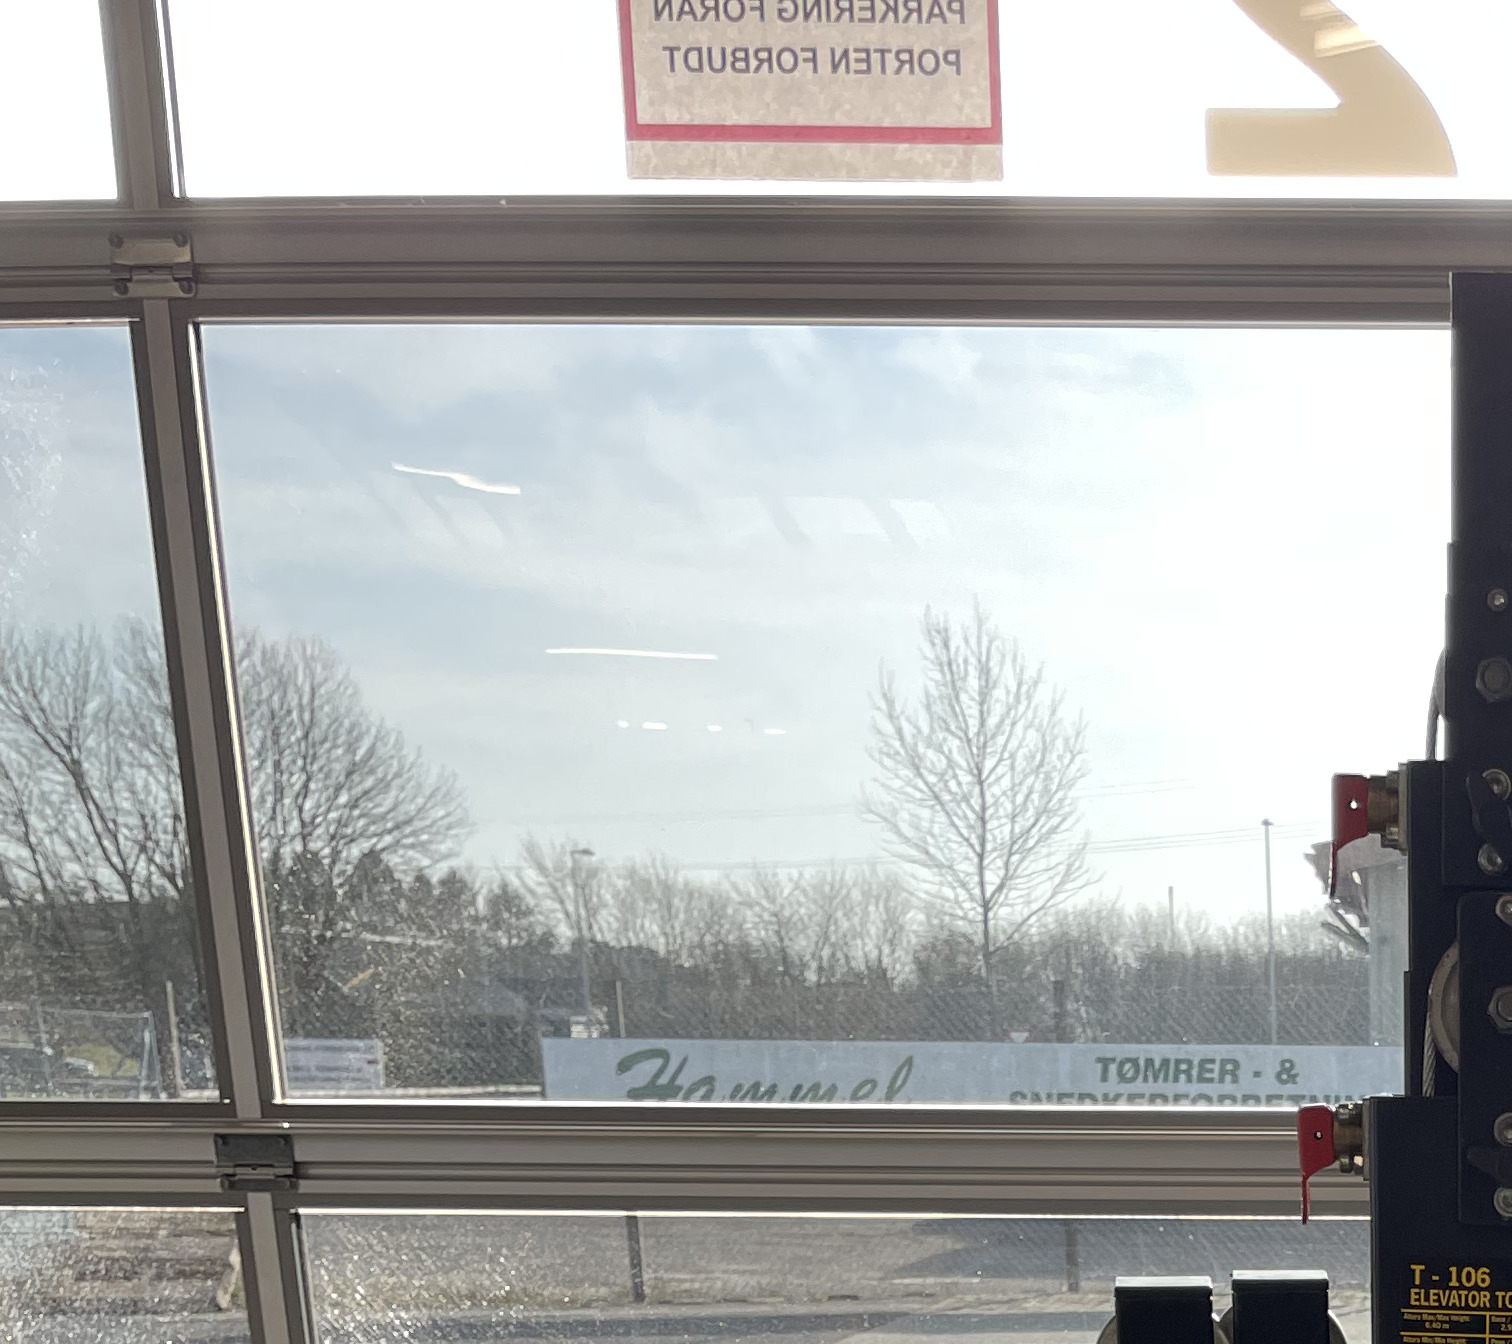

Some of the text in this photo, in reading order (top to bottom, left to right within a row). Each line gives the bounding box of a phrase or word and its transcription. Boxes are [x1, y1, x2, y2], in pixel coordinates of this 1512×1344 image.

[1096, 1055, 1241, 1085] TØMRER
[1274, 1058, 1299, 1085] &
[1410, 1264, 1425, 1285] T
[1448, 1266, 1491, 1288] 106
[1409, 1288, 1491, 1308] ELEVATOR
